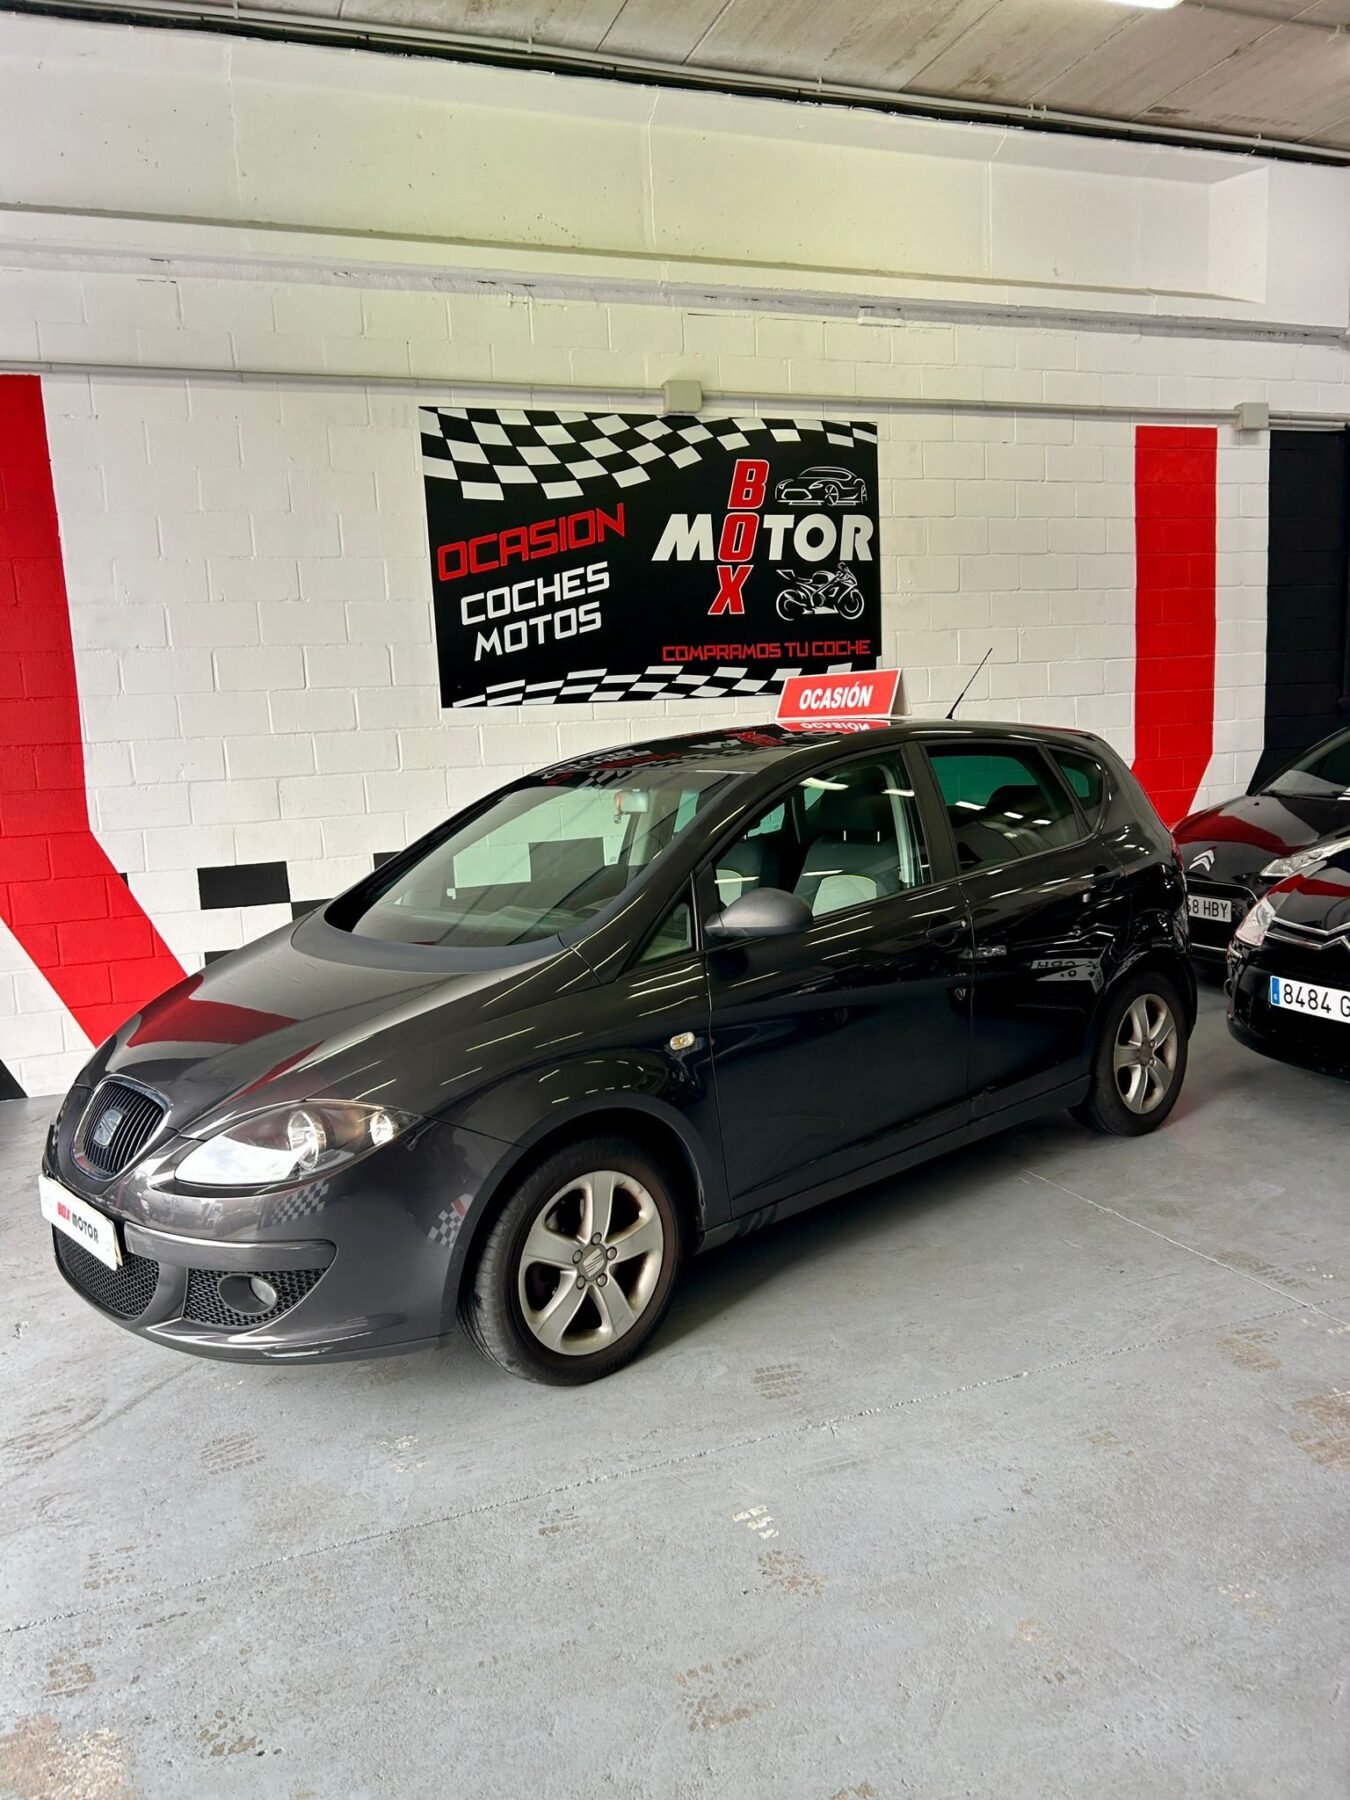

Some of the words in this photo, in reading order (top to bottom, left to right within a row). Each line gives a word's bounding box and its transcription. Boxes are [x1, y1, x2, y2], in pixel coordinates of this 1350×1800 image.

[437, 502, 626, 582] OCASION
[651, 512, 874, 563] MOTOR
[707, 459, 770, 615] BOX
[460, 560, 610, 626] COCHES
[474, 600, 602, 662] MOTOS
[662, 643, 782, 662] COMPRAMOS
[784, 641, 809, 658] TU
[812, 640, 871, 656] COCHE
[799, 681, 874, 710] OCASIÓN
[1203, 900, 1228, 919] HBY
[1283, 983, 1332, 1014] 8484
[72, 1212, 99, 1244] MOTOR
